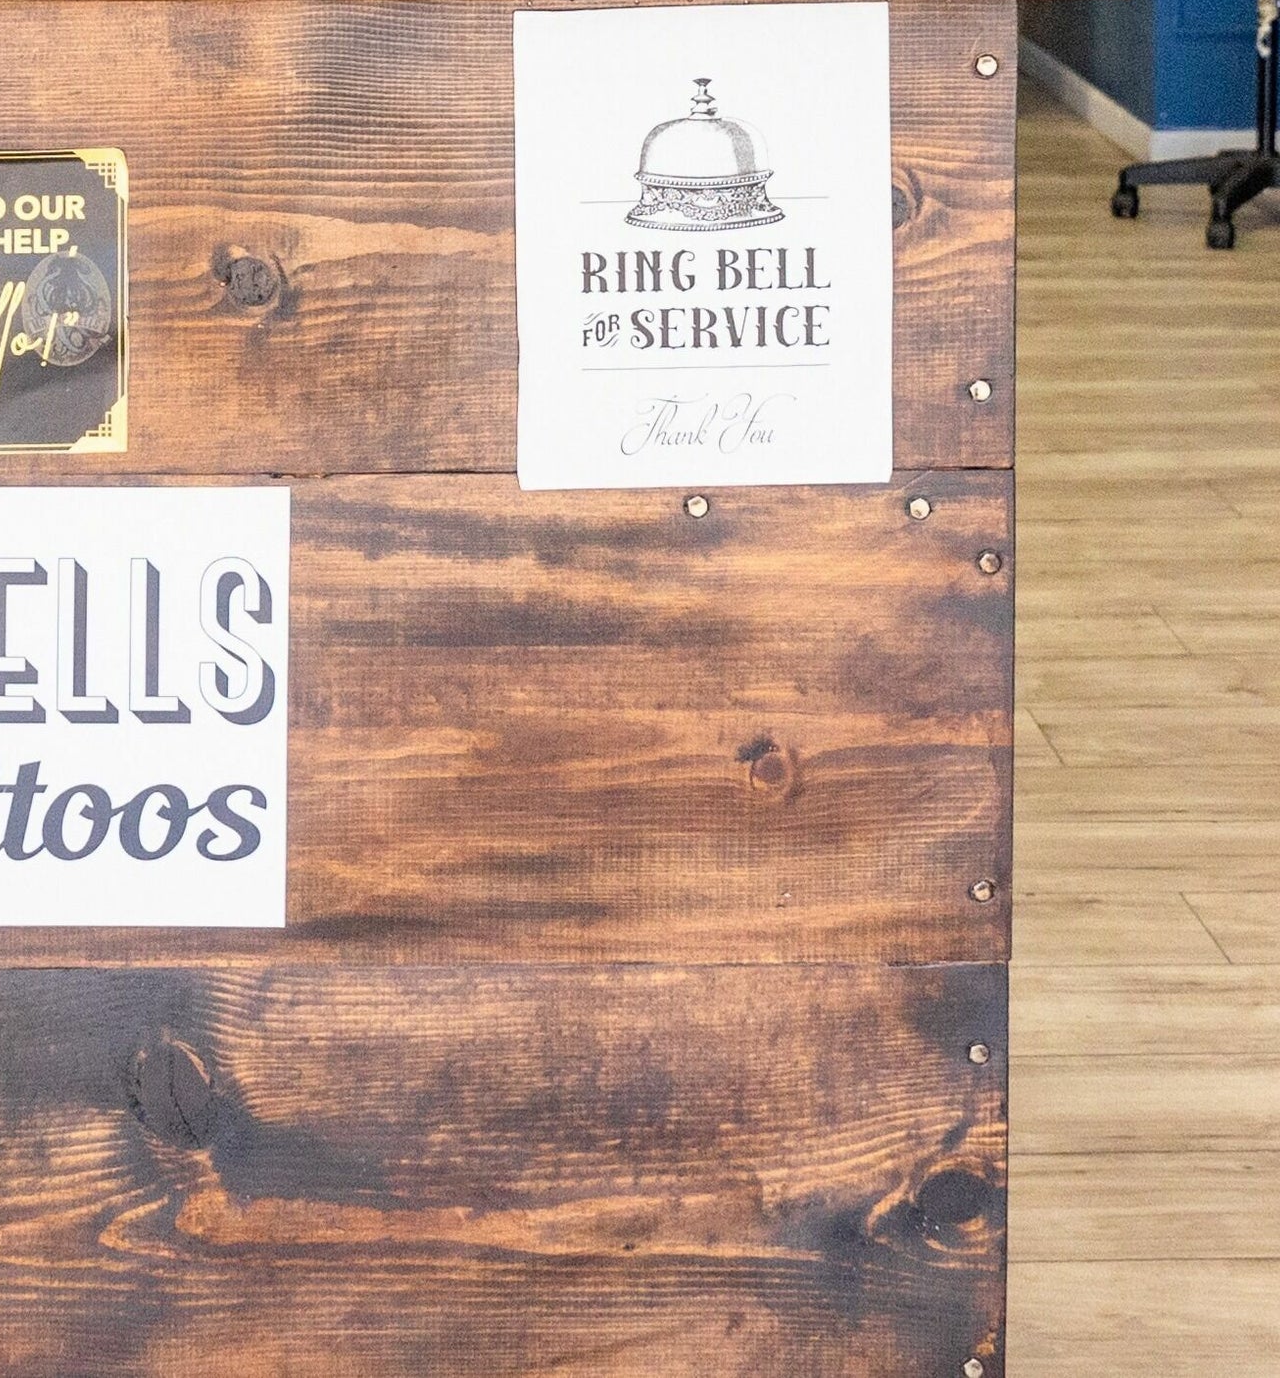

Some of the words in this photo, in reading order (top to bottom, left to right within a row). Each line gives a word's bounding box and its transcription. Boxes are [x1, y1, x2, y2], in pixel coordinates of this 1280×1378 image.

[13, 194, 86, 221] OUR
[581, 249, 696, 294] RING
[715, 246, 832, 291] BELL
[582, 313, 621, 348] FOR
[629, 304, 831, 350] SERVICE
[619, 392, 720, 457] Thank
[717, 391, 799, 456] You
